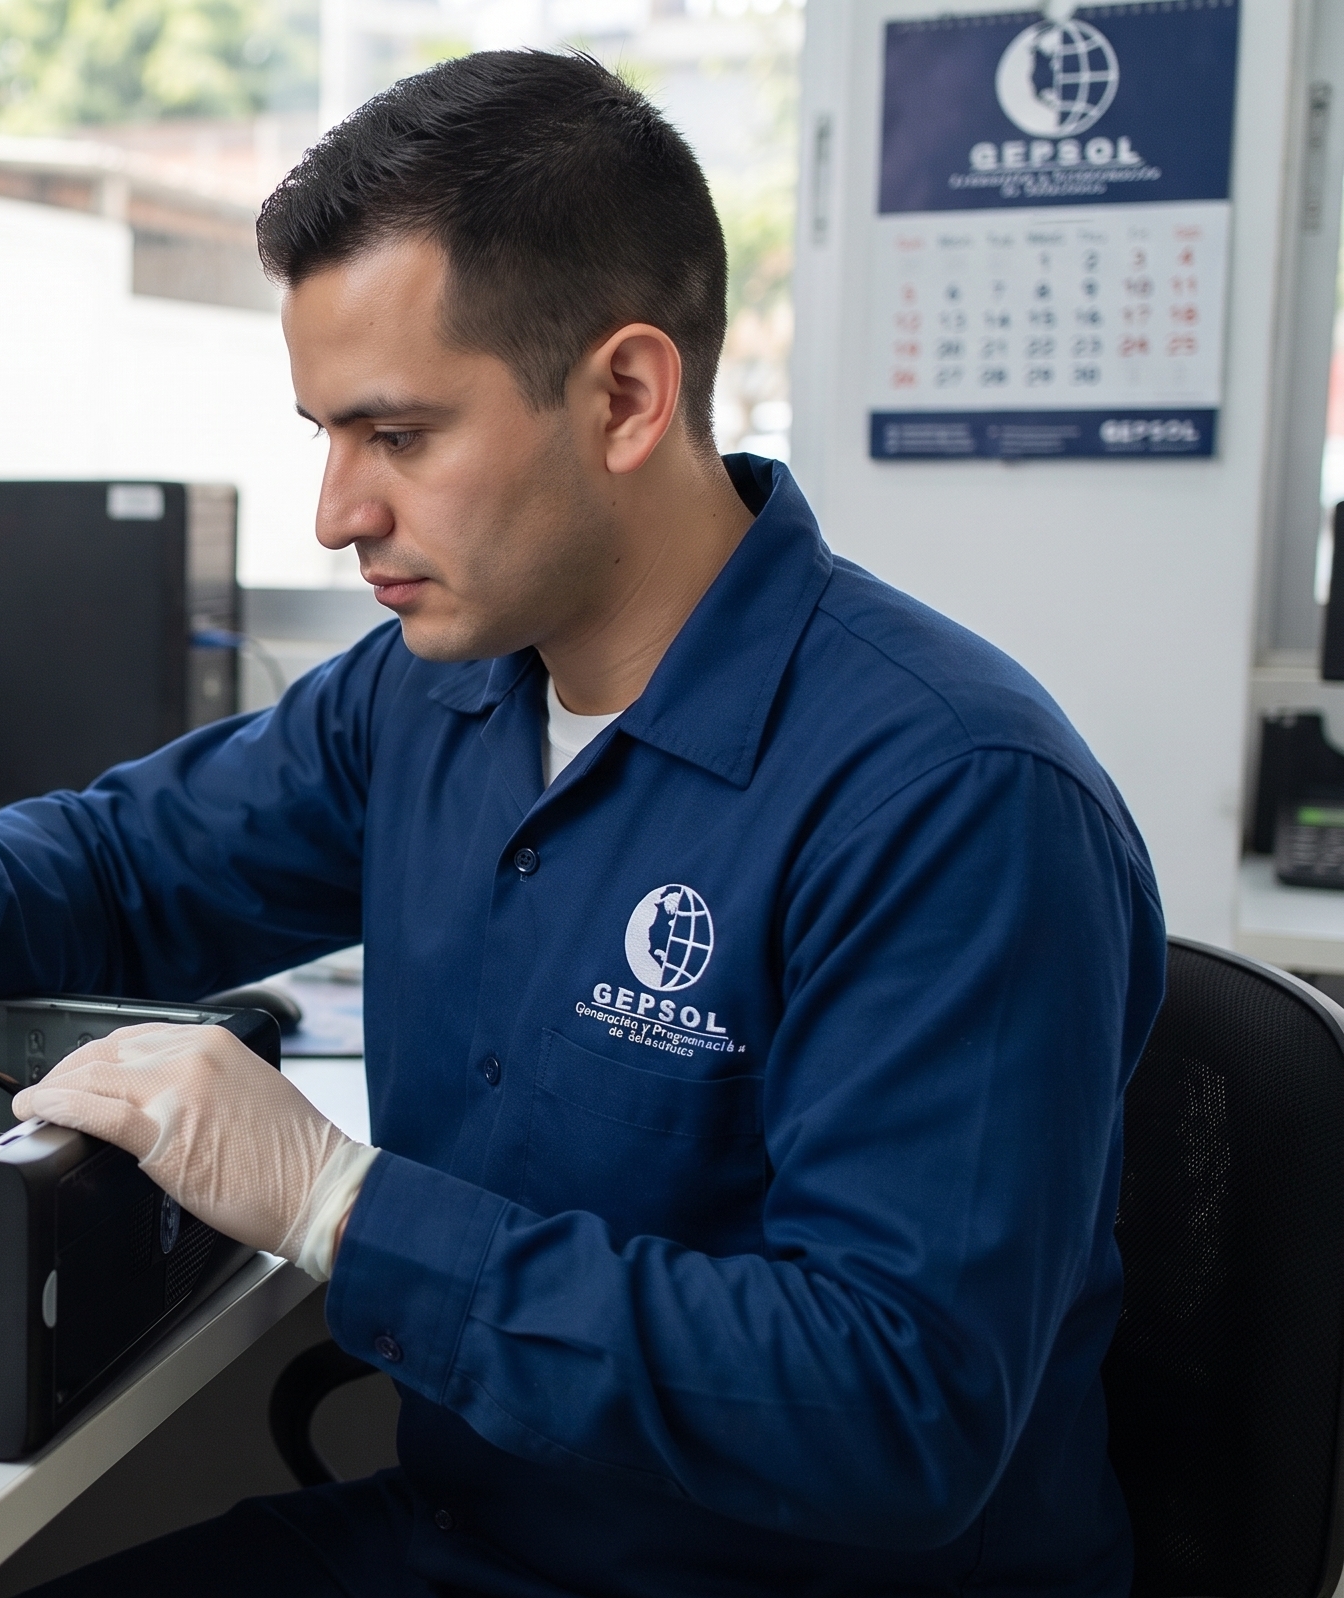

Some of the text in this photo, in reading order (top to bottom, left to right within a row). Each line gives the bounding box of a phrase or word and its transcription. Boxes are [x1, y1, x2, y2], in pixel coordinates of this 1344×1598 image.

[969, 137, 1144, 170] GEPSOL
[593, 982, 727, 1034] GEPSOL
[608, 1026, 624, 1038] de
